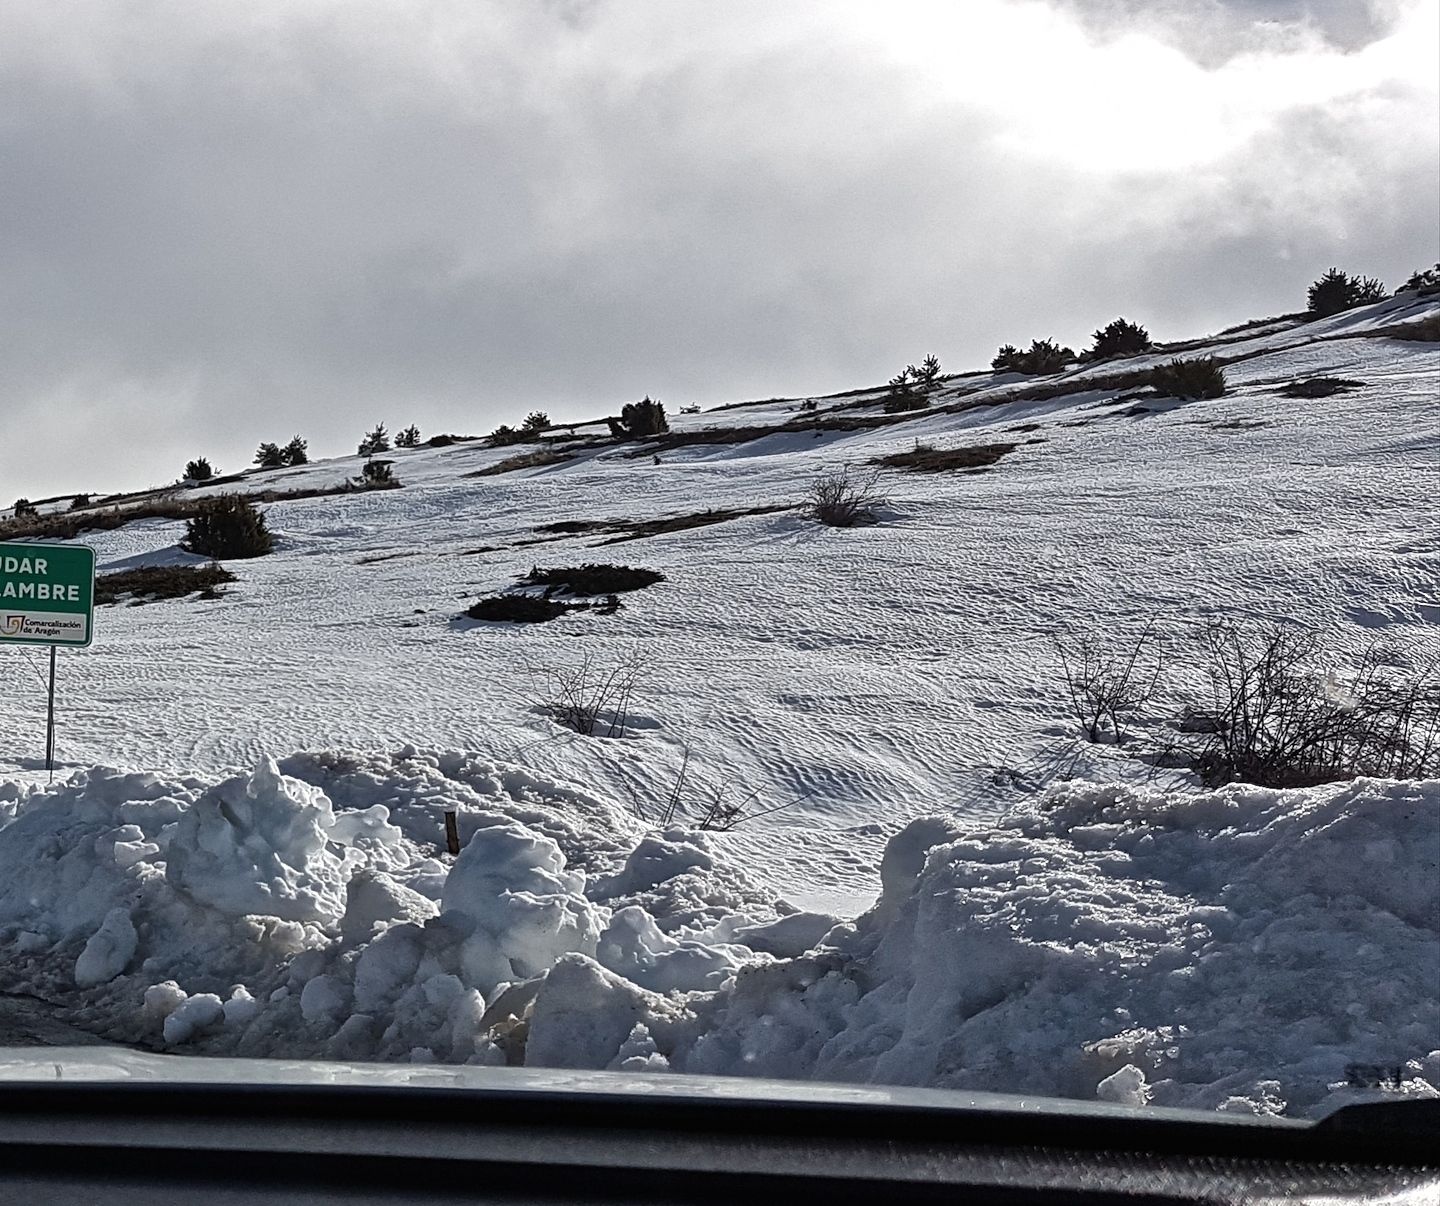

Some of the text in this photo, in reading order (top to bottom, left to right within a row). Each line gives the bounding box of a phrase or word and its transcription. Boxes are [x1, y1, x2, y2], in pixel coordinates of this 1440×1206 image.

[24, 618, 82, 629] Comarcalización
[23, 626, 61, 636] de Aragón
